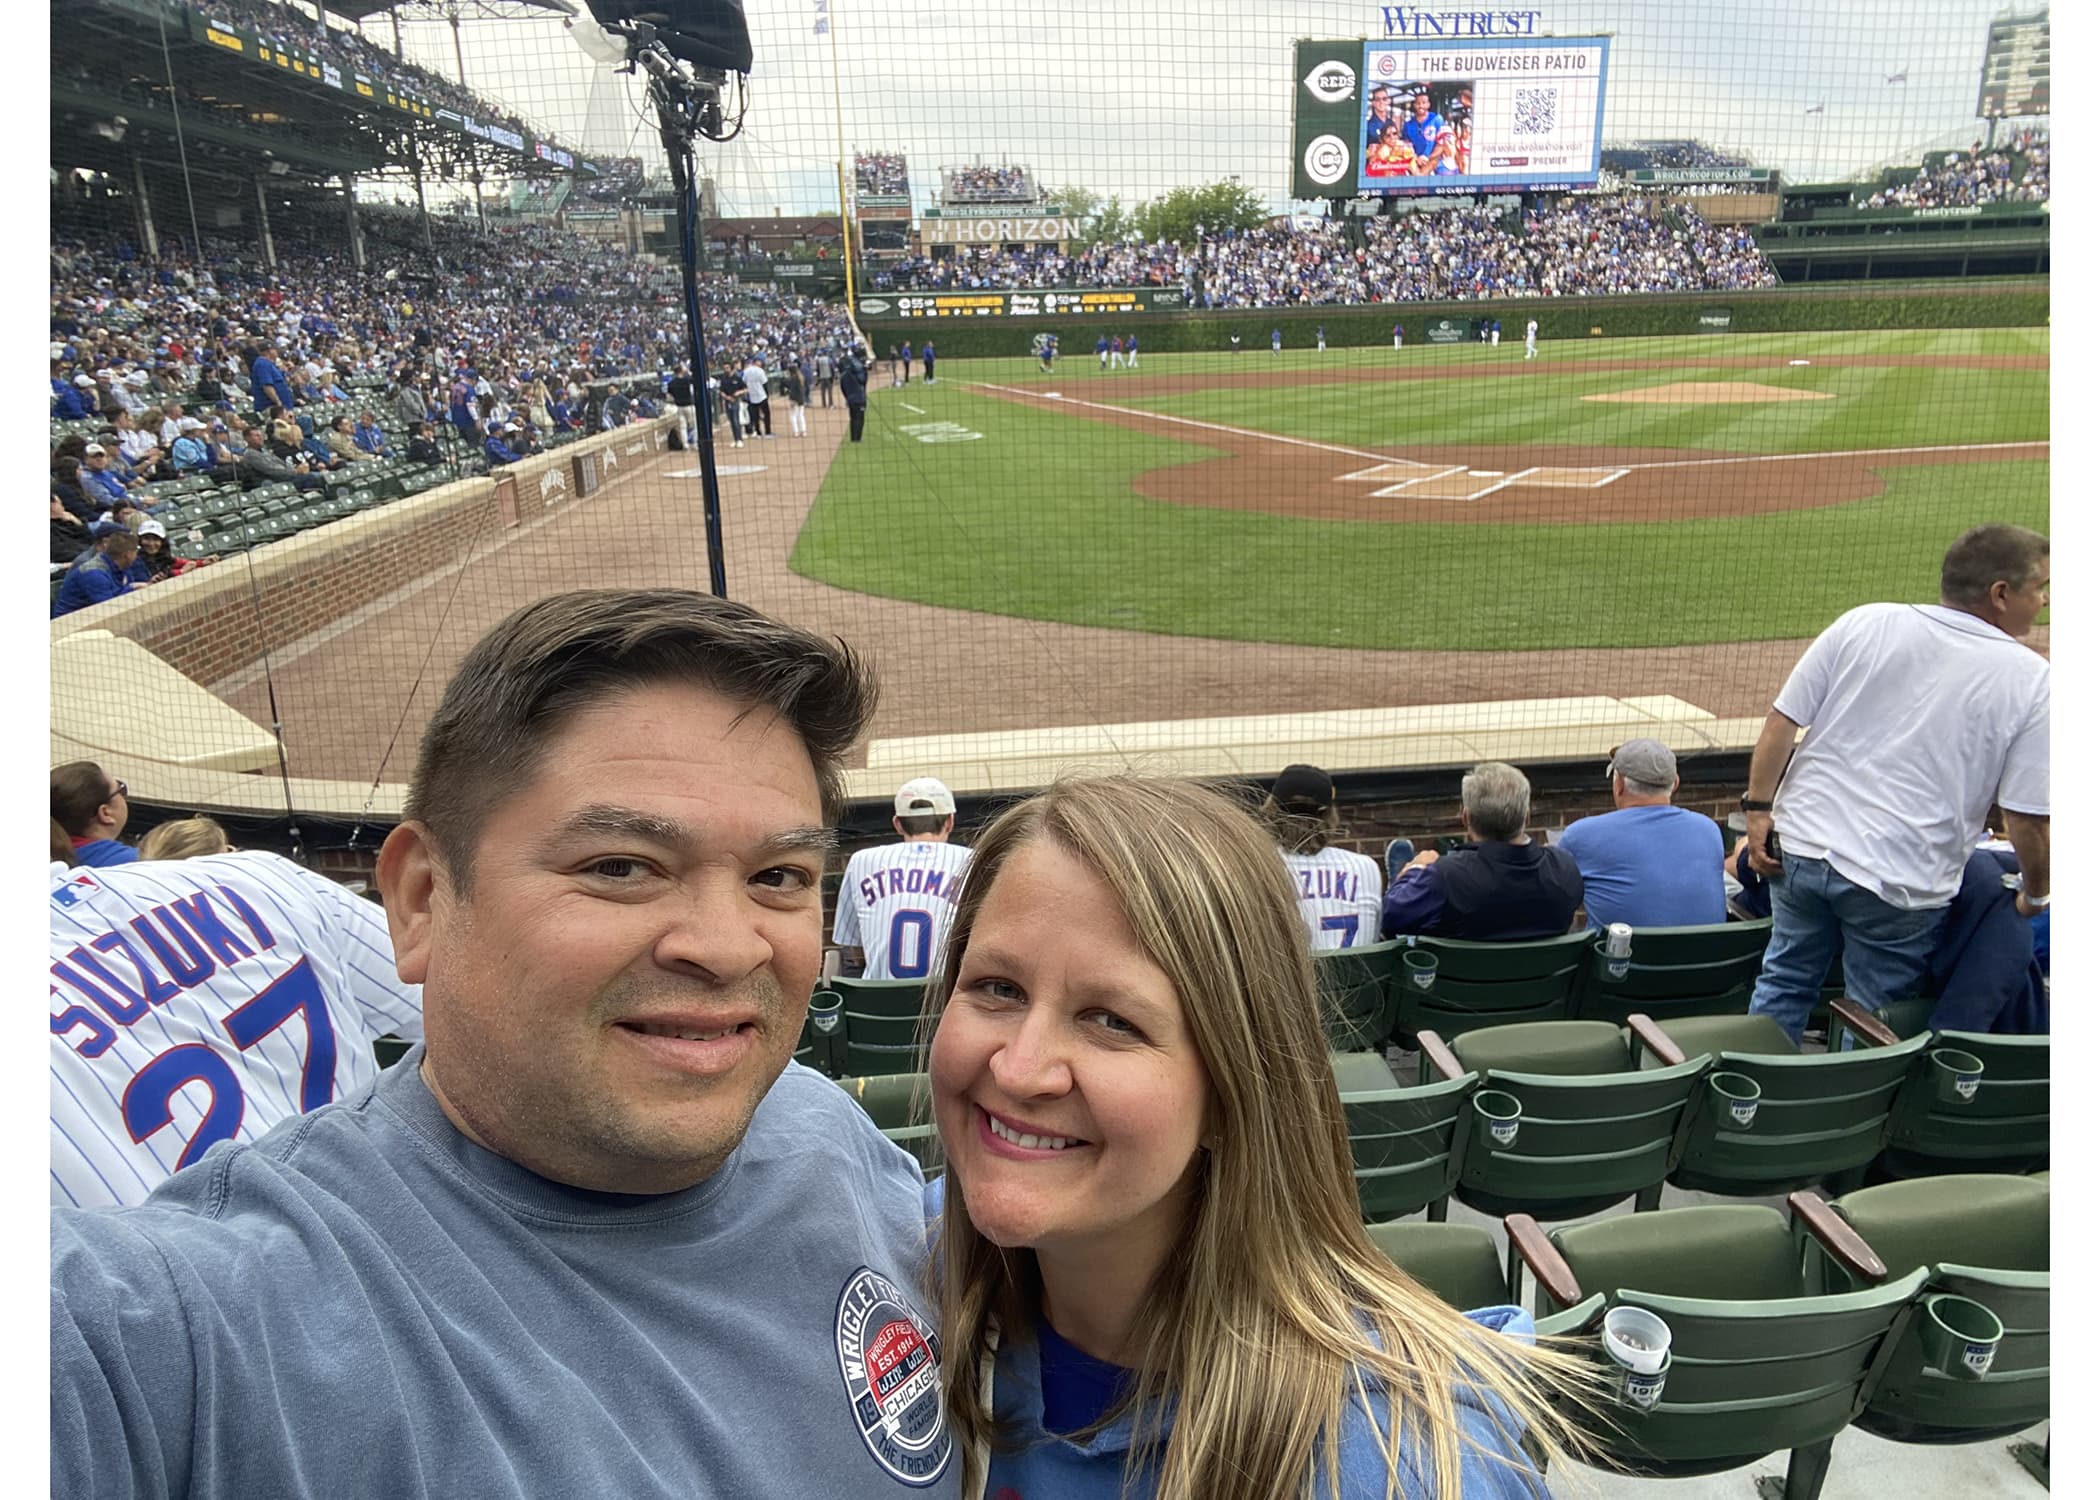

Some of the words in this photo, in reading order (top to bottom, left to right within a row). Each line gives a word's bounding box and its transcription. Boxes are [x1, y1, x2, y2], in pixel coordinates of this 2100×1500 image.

[1381, 6, 1541, 36] WINTRUST
[1319, 75, 1356, 89] REDS
[1422, 57, 1449, 72] THE
[1454, 56, 1539, 71] BUDWEISER
[1544, 55, 1586, 70] PATIO
[956, 218, 1080, 242] HORIZON
[860, 868, 962, 907] STROMA
[1299, 869, 1359, 903] ZUKI
[889, 908, 933, 978] 0
[1319, 913, 1360, 949] 7
[50, 884, 277, 1058] SUZUKI
[121, 953, 338, 1174] 27
[841, 1276, 879, 1381] WRIGLEY
[868, 1326, 896, 1363] WRIGLEY
[876, 1349, 899, 1372] EST.
[896, 1335, 915, 1356] 1914
[858, 1393, 878, 1426] 19
[885, 1365, 935, 1417] CHICAGO
[905, 1394, 935, 1423] WORLD
[878, 1433, 898, 1466] THE
[900, 1446, 942, 1475] FRIENDLY
